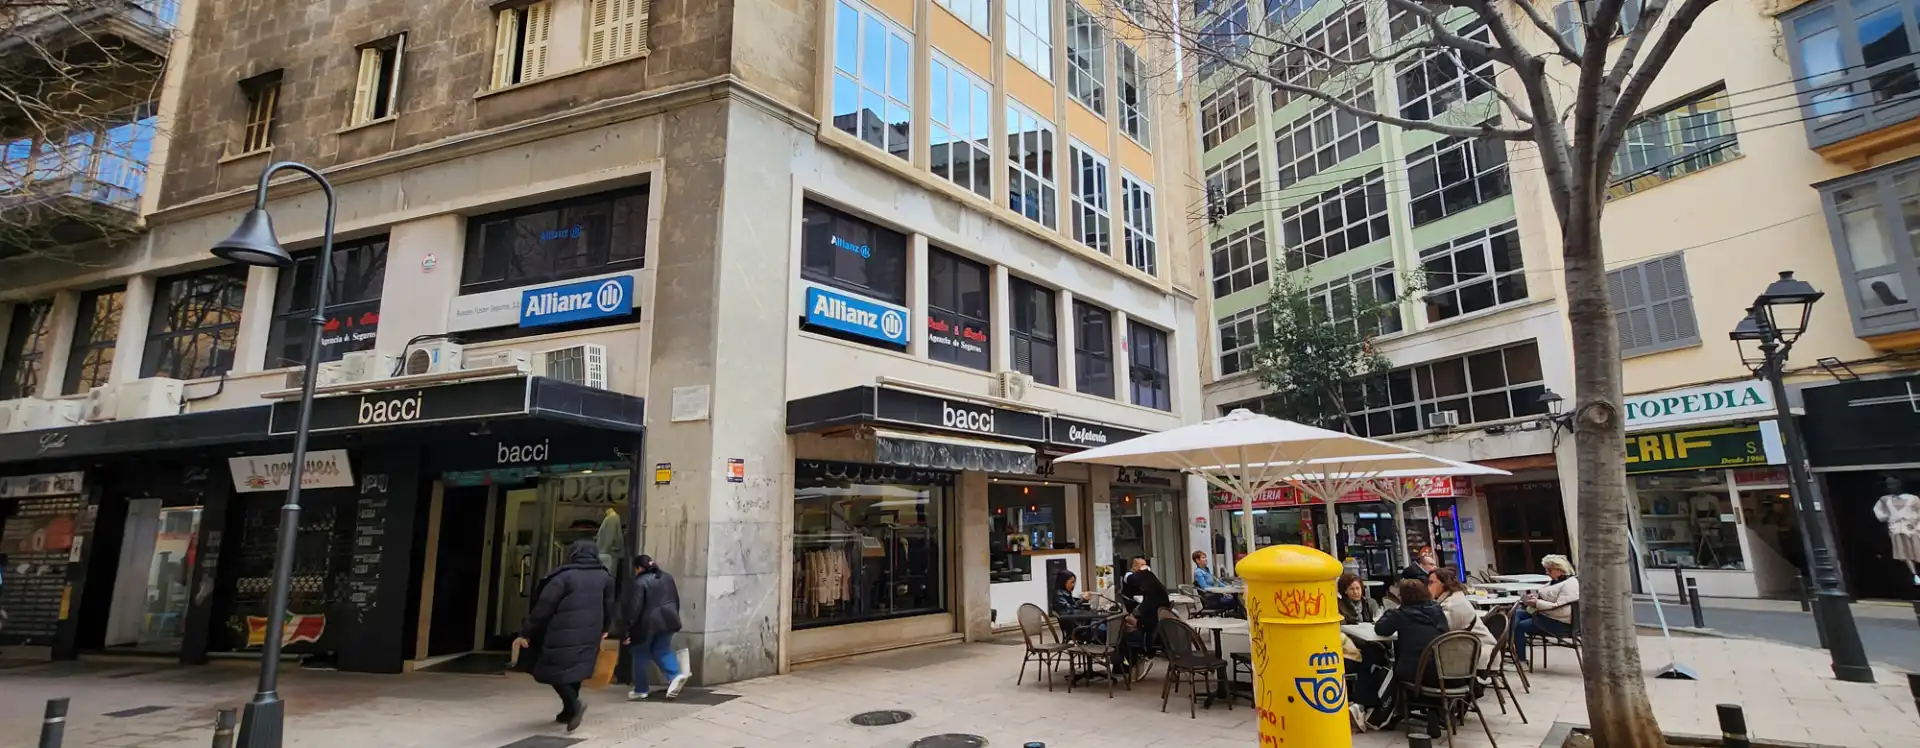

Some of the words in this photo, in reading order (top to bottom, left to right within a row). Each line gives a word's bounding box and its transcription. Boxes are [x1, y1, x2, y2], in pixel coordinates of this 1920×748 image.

[831, 234, 859, 253] Allianz
[525, 291, 593, 317] Allianz
[813, 294, 878, 329] Allianz
[352, 332, 376, 342] Seguros
[929, 333, 951, 345] Agencia
[952, 339, 960, 347] de
[960, 340, 982, 353] Seguros
[358, 390, 423, 424] bacci
[1624, 387, 1766, 419] TOPEDIA
[943, 401, 995, 433] bacci
[1068, 424, 1107, 444] Cafetería
[497, 438, 549, 463] bacci
